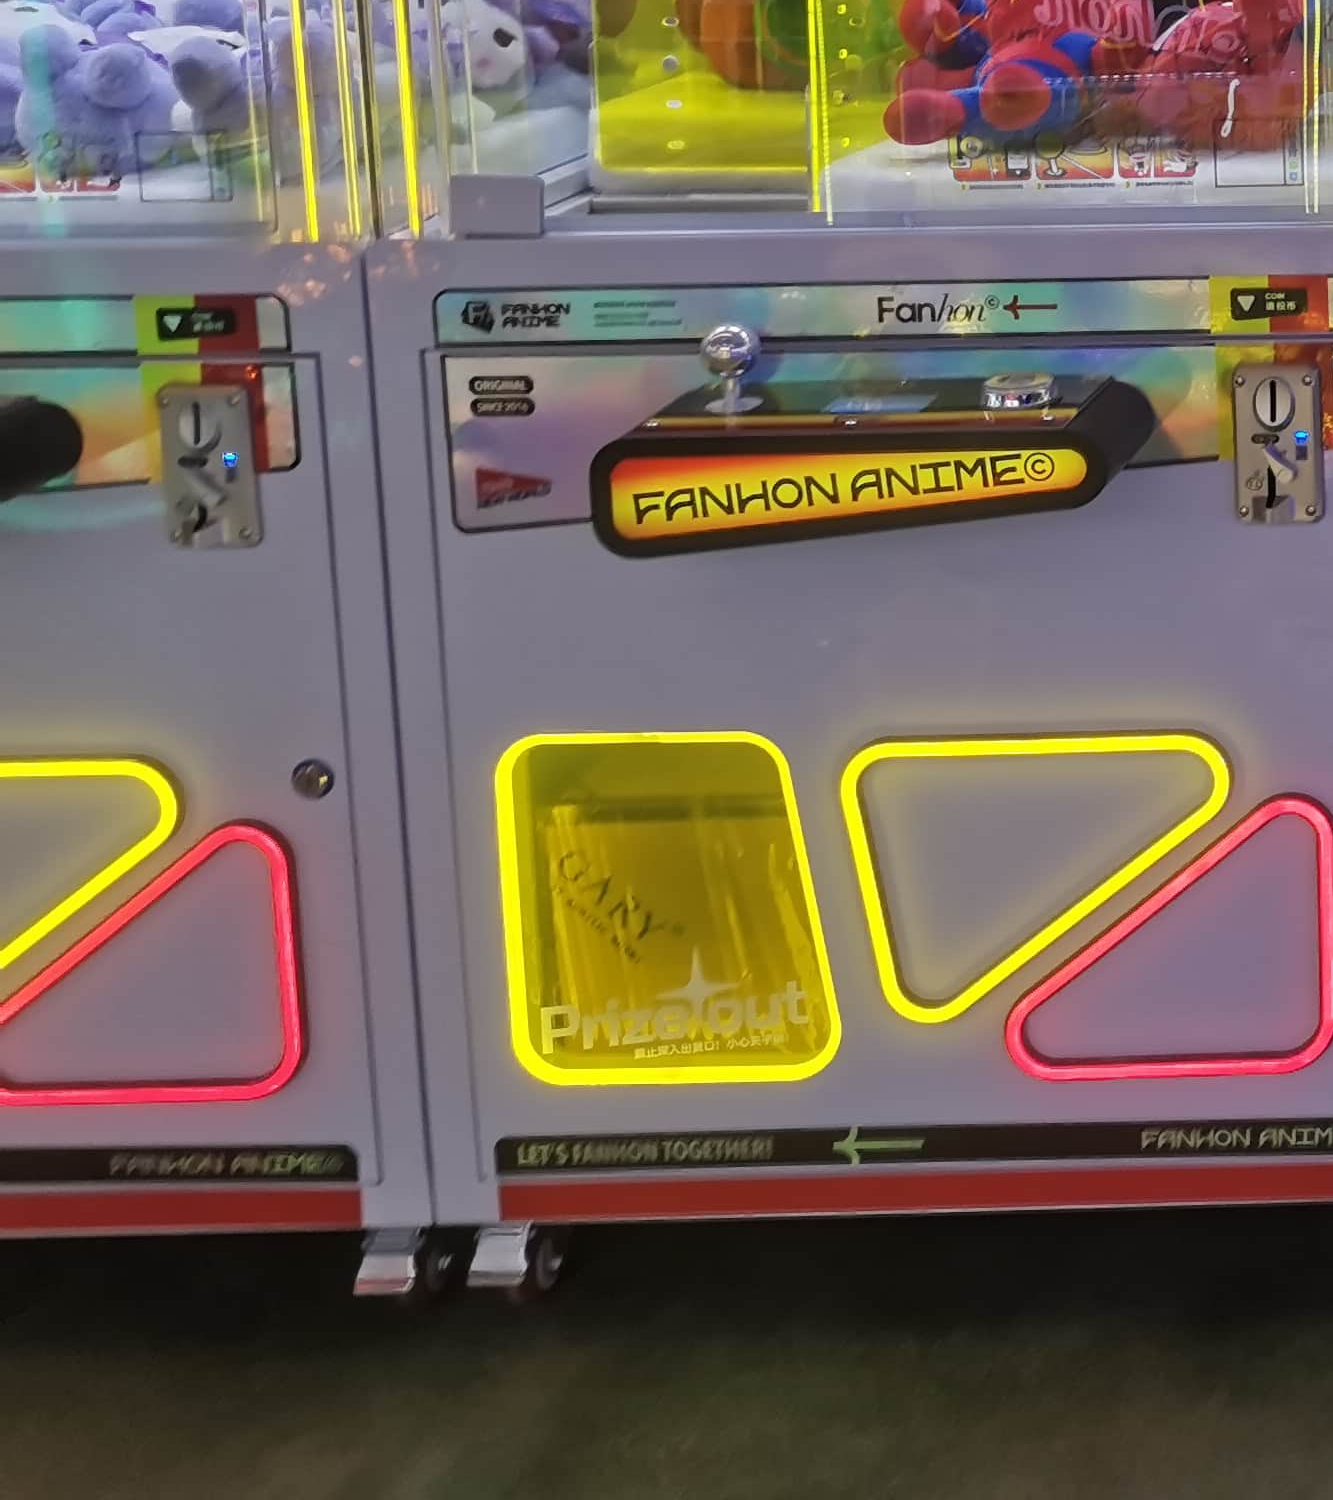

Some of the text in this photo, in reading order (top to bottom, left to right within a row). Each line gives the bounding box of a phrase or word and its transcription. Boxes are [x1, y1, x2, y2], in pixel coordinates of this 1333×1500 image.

[501, 302, 570, 315] FANHON
[633, 472, 842, 526] FANHON
[540, 980, 811, 1055] Prize out
[1141, 1127, 1252, 1149] FANHON
